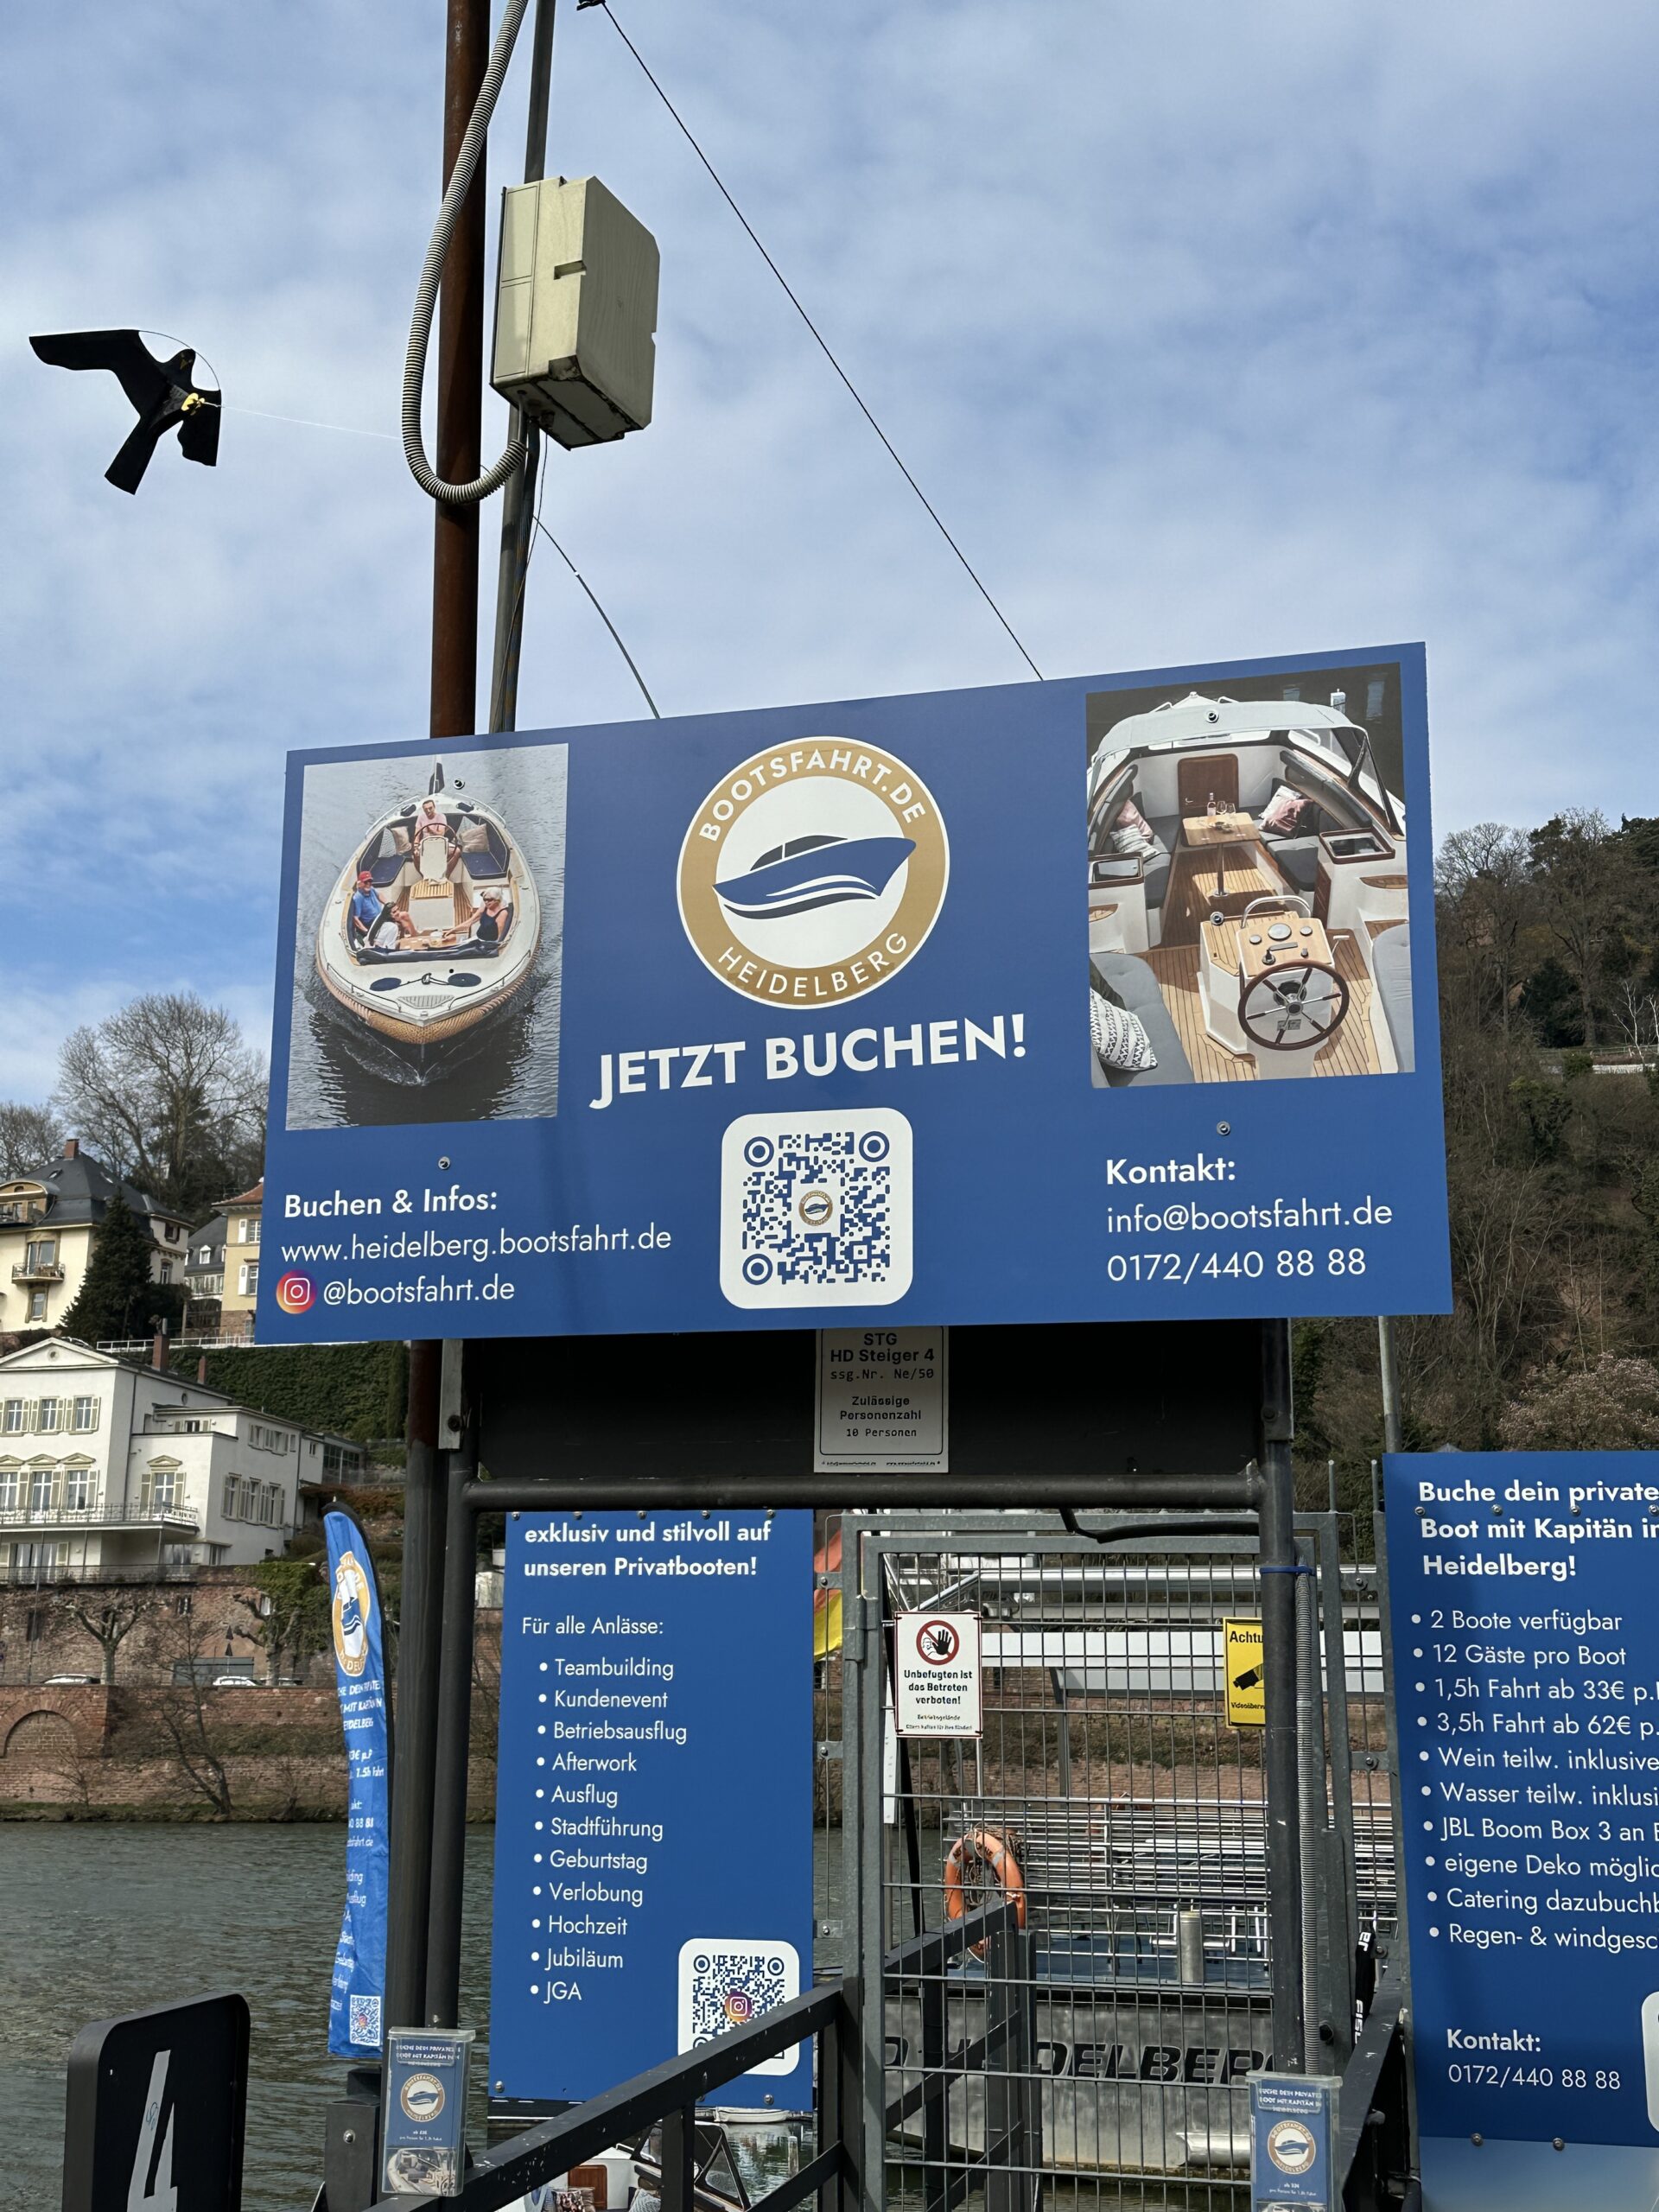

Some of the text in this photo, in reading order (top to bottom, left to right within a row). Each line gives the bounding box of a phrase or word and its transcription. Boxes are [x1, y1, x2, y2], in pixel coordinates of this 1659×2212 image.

[699, 748, 926, 842] BOOTSFAHRT.DE
[718, 932, 907, 997] HEIDELBERG
[588, 1013, 1027, 1109] JETZT BUCHEN!
[1106, 1153, 1236, 1185] Kontakt:
[284, 1184, 497, 1218] Buchen & Infos:
[1107, 1195, 1393, 1233] info@bootsfahrt.de
[281, 1222, 671, 1262] www.heidelberg.bootsfahrt.de
[1107, 1248, 1366, 1285] 0172/440 88 88
[323, 1273, 515, 1306] @bootsfahrt.de
[863, 1332, 898, 1346] STG
[830, 1347, 935, 1365] HD Steiger 4
[851, 1395, 910, 1408] Zulässige
[840, 1410, 922, 1421] Personenzahl
[846, 1428, 917, 1438] 10 Personen
[1419, 1478, 1659, 1507] Buche dein private
[524, 1519, 772, 1543] exklusiv und stilvoll auf
[1421, 1518, 1479, 1539] Boot
[1487, 1517, 1526, 1538] mit
[1534, 1517, 1633, 1544] Kapitän
[524, 1554, 757, 1577] unseren Privatbooten!
[1423, 1553, 1576, 1582] Heidelberg!
[522, 1615, 664, 1635] Für alle Anlässe:
[1431, 1609, 1623, 1636] 2 Boote verfügbar
[1230, 1630, 1263, 1643] Achtu
[555, 1656, 674, 1681] Teambuilding
[1433, 1643, 1626, 1669] 12 Gäste pro Boot
[904, 1669, 973, 1681] Unbefugten ist
[908, 1682, 968, 1692] das Betreten
[555, 1688, 669, 1708] Kundenevent
[916, 1695, 961, 1705] verboten!
[1434, 1676, 1659, 1706] 1,5h Fahrt ab 33€ p.
[554, 1719, 687, 1745] Betriebsausflug
[1437, 1711, 1484, 1736] 3,5h
[1492, 1712, 1546, 1733] Fahrt
[1553, 1713, 1580, 1734] ab
[1587, 1715, 1631, 1735] 62€
[551, 1751, 637, 1771] Afterwork
[1437, 1746, 1495, 1767] Wein
[1503, 1746, 1559, 1769] teilw.
[550, 1783, 618, 1808] Ausflug
[1440, 1782, 1520, 1803] Wasser
[1526, 1783, 1582, 1805] teilw.
[550, 1815, 664, 1842] Stadtführung
[1440, 1816, 1475, 1841] JBL
[1482, 1818, 1542, 1839] Boom
[1551, 1820, 1590, 1840] Box
[1599, 1821, 1611, 1841] 3
[1619, 1827, 1644, 1841] an
[550, 1848, 648, 1875] Geburtstag
[1445, 1853, 1518, 1878] eigene
[1526, 1853, 1581, 1876] Deko
[549, 1880, 643, 1908] Verlobung
[1446, 1887, 1538, 1916] Catering
[549, 1914, 628, 1936] Hochzeit
[1449, 1923, 1522, 1949] Regen-
[1529, 1925, 1548, 1946] &
[543, 1946, 623, 1971] Jubiläum
[543, 1980, 582, 2005] JGA
[1446, 2028, 1541, 2052] Kontakt:
[1448, 2064, 1621, 2090] 0172/440 88 88
